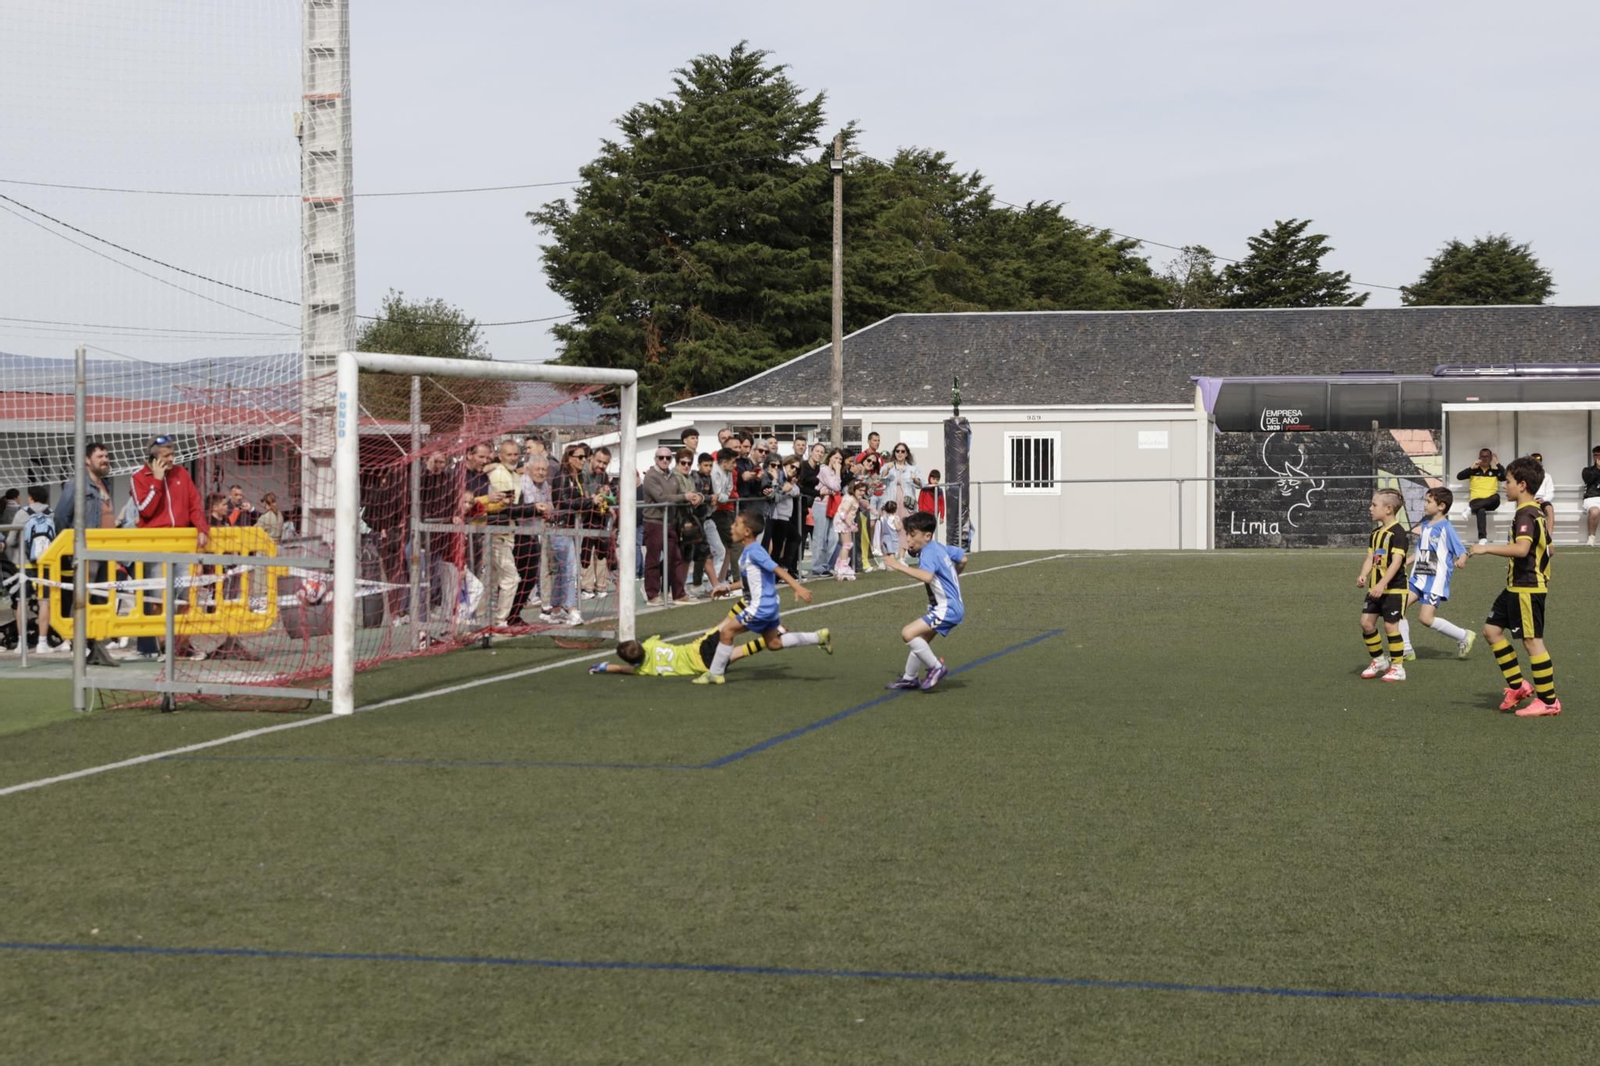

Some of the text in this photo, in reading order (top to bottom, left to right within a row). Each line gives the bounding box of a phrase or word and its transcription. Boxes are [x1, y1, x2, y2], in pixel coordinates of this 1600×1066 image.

[338, 393, 346, 437] MONDO
[1282, 415, 1299, 424] AÑO
[1231, 511, 1281, 534] Limia
